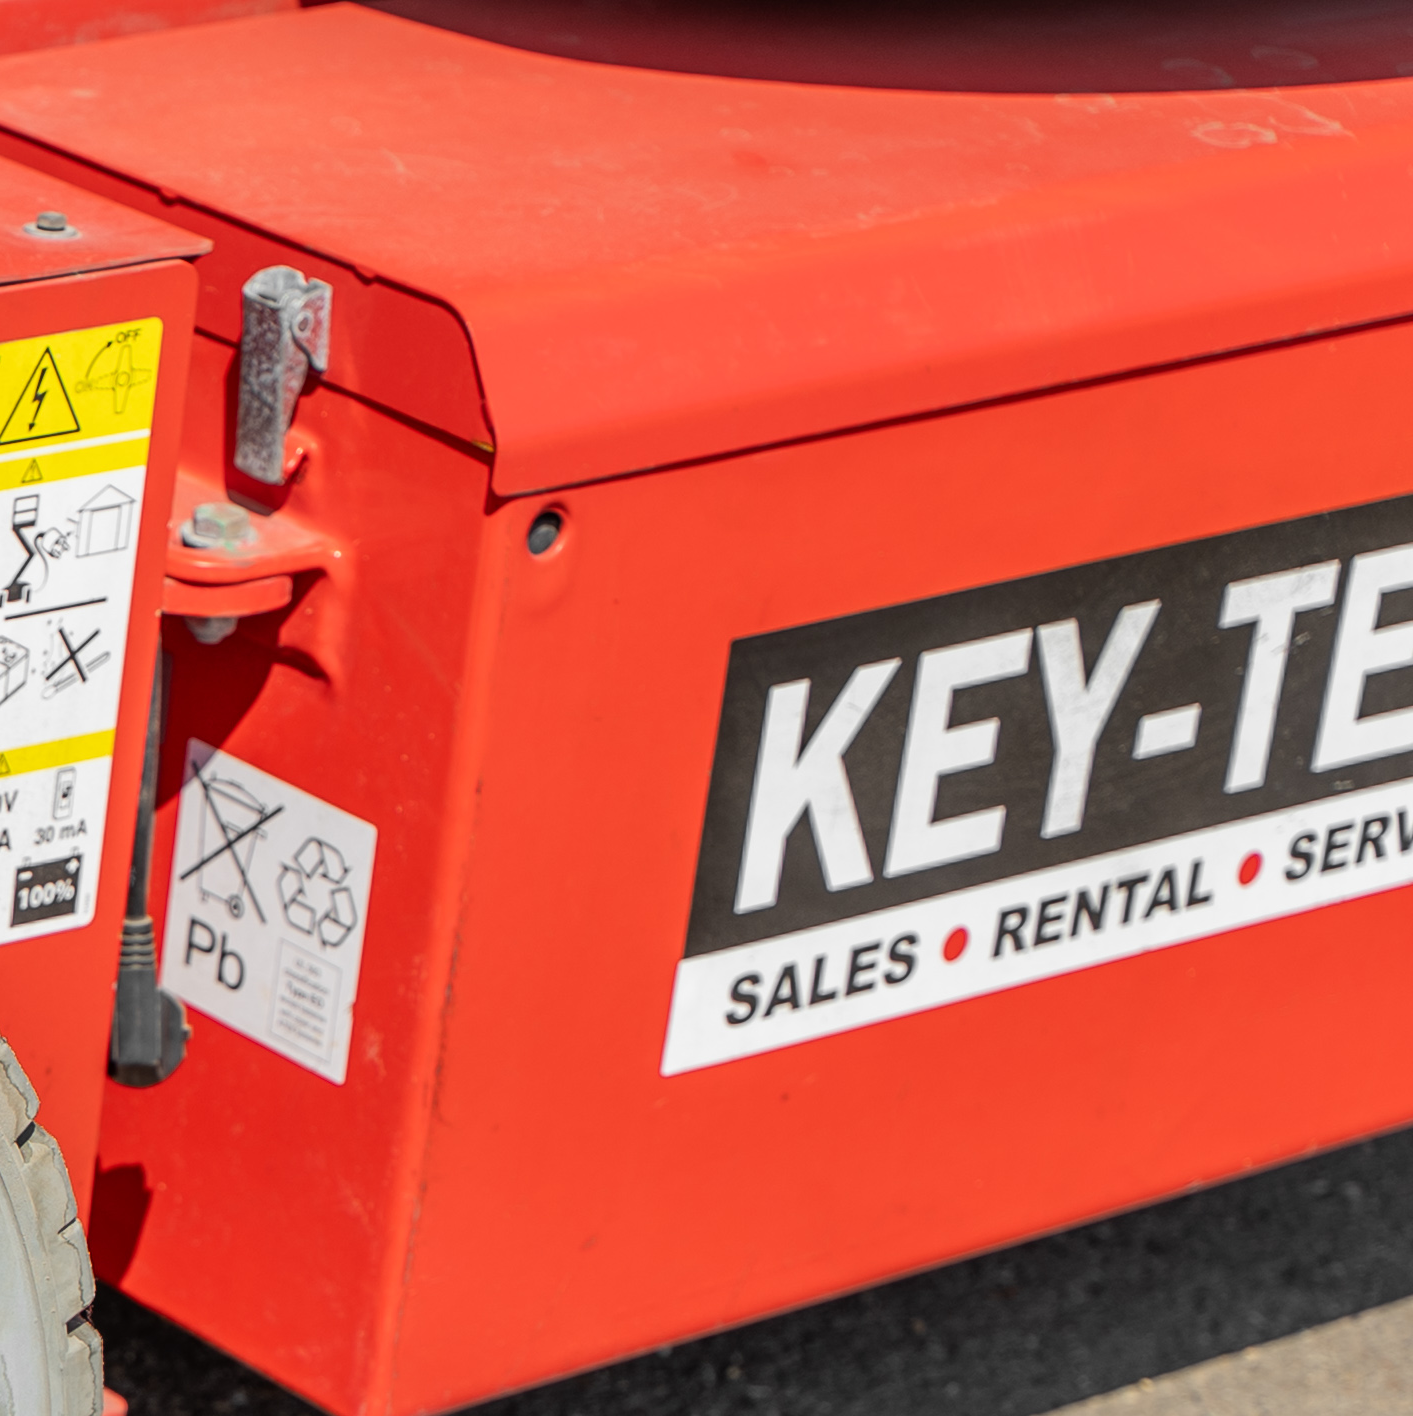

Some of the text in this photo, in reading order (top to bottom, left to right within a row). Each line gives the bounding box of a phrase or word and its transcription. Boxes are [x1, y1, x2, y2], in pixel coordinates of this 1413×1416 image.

[116, 327, 142, 344] OFF
[34, 819, 88, 847] 30 mA
[18, 878, 76, 910] 100%
[185, 916, 246, 991] Pb
[725, 932, 922, 1028] SALES
[992, 857, 1214, 958] RENTAL
